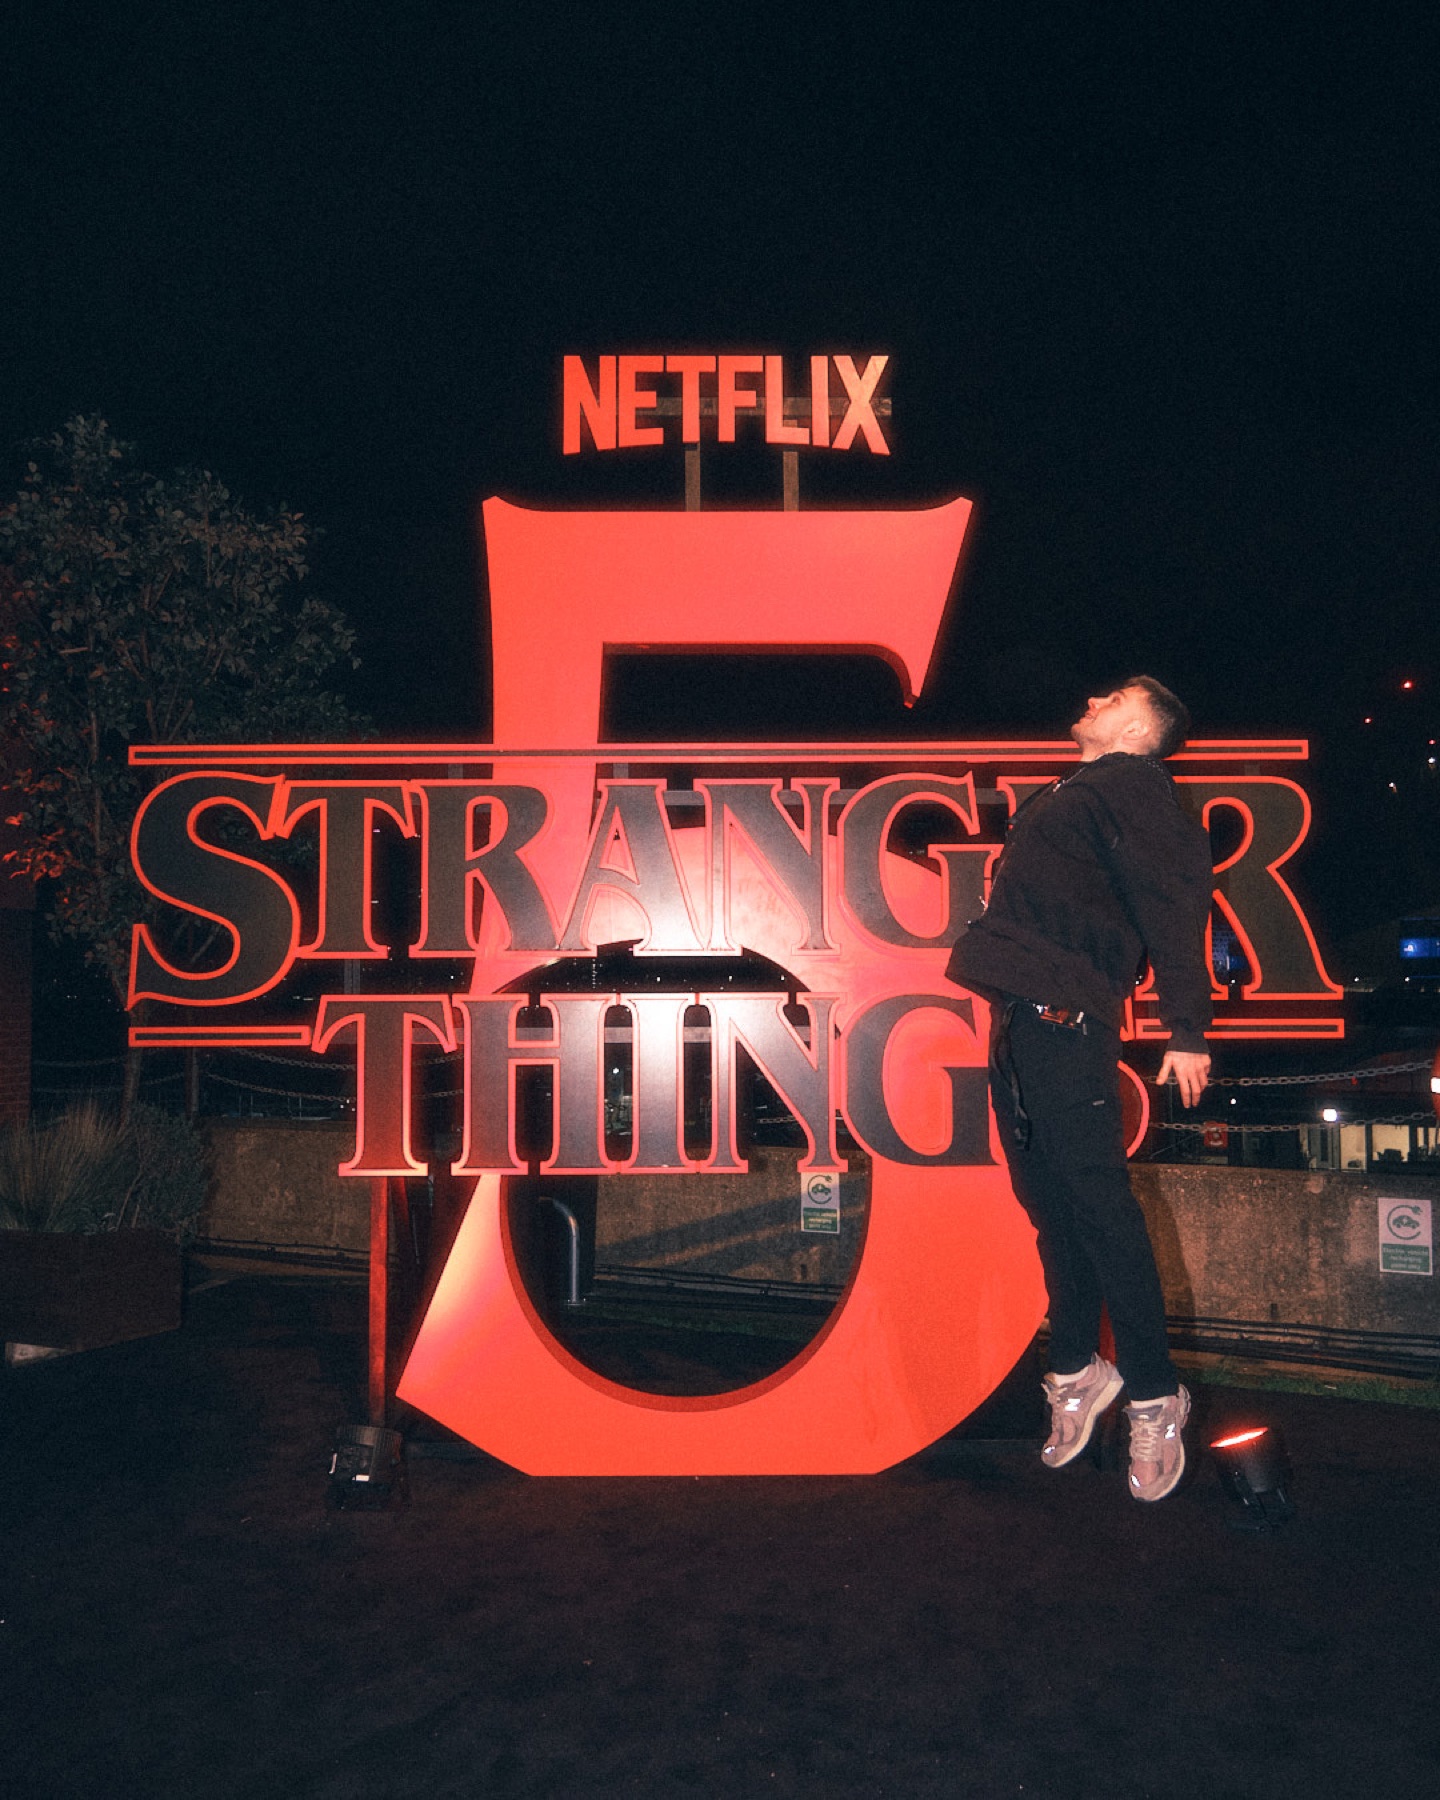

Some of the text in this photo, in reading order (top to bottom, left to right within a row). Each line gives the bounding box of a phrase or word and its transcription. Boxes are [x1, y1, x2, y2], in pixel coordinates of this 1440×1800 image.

[563, 355, 891, 456] NETFLIX
[127, 770, 1344, 1011] STRANGR
[396, 496, 1050, 1477] 5
[311, 990, 1150, 1178] THING
